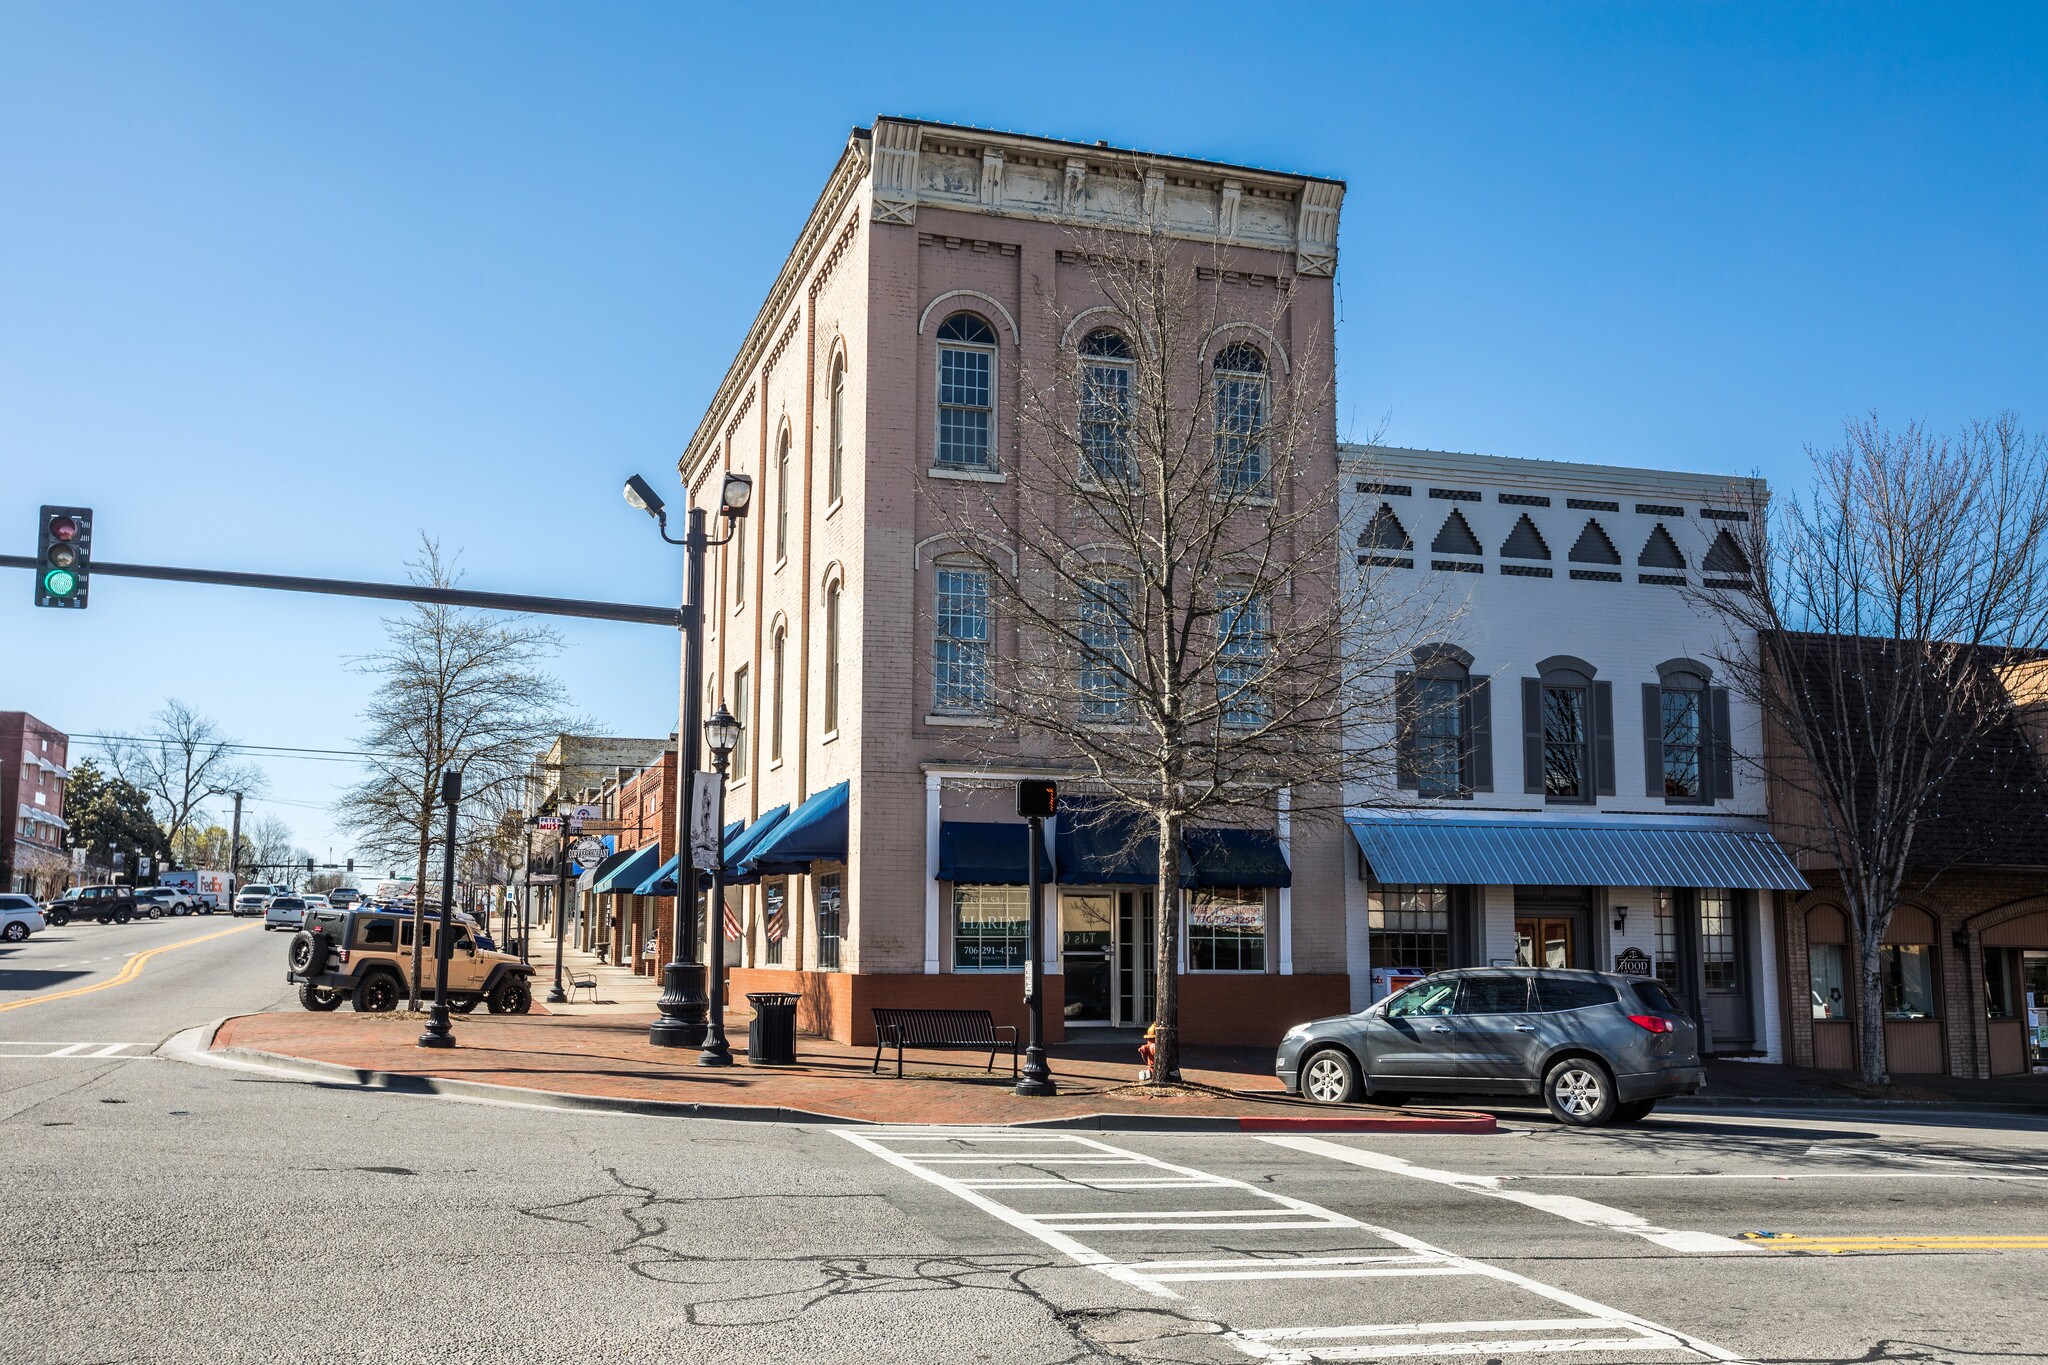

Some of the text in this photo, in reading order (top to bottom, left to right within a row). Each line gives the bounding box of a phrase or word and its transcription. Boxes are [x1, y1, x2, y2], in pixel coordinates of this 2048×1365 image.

[568, 849, 610, 859] COFFEE COMPANY
[201, 876, 223, 892] FedEx
[961, 915, 1021, 930] HARDY
[1620, 961, 1648, 970] HOOD
